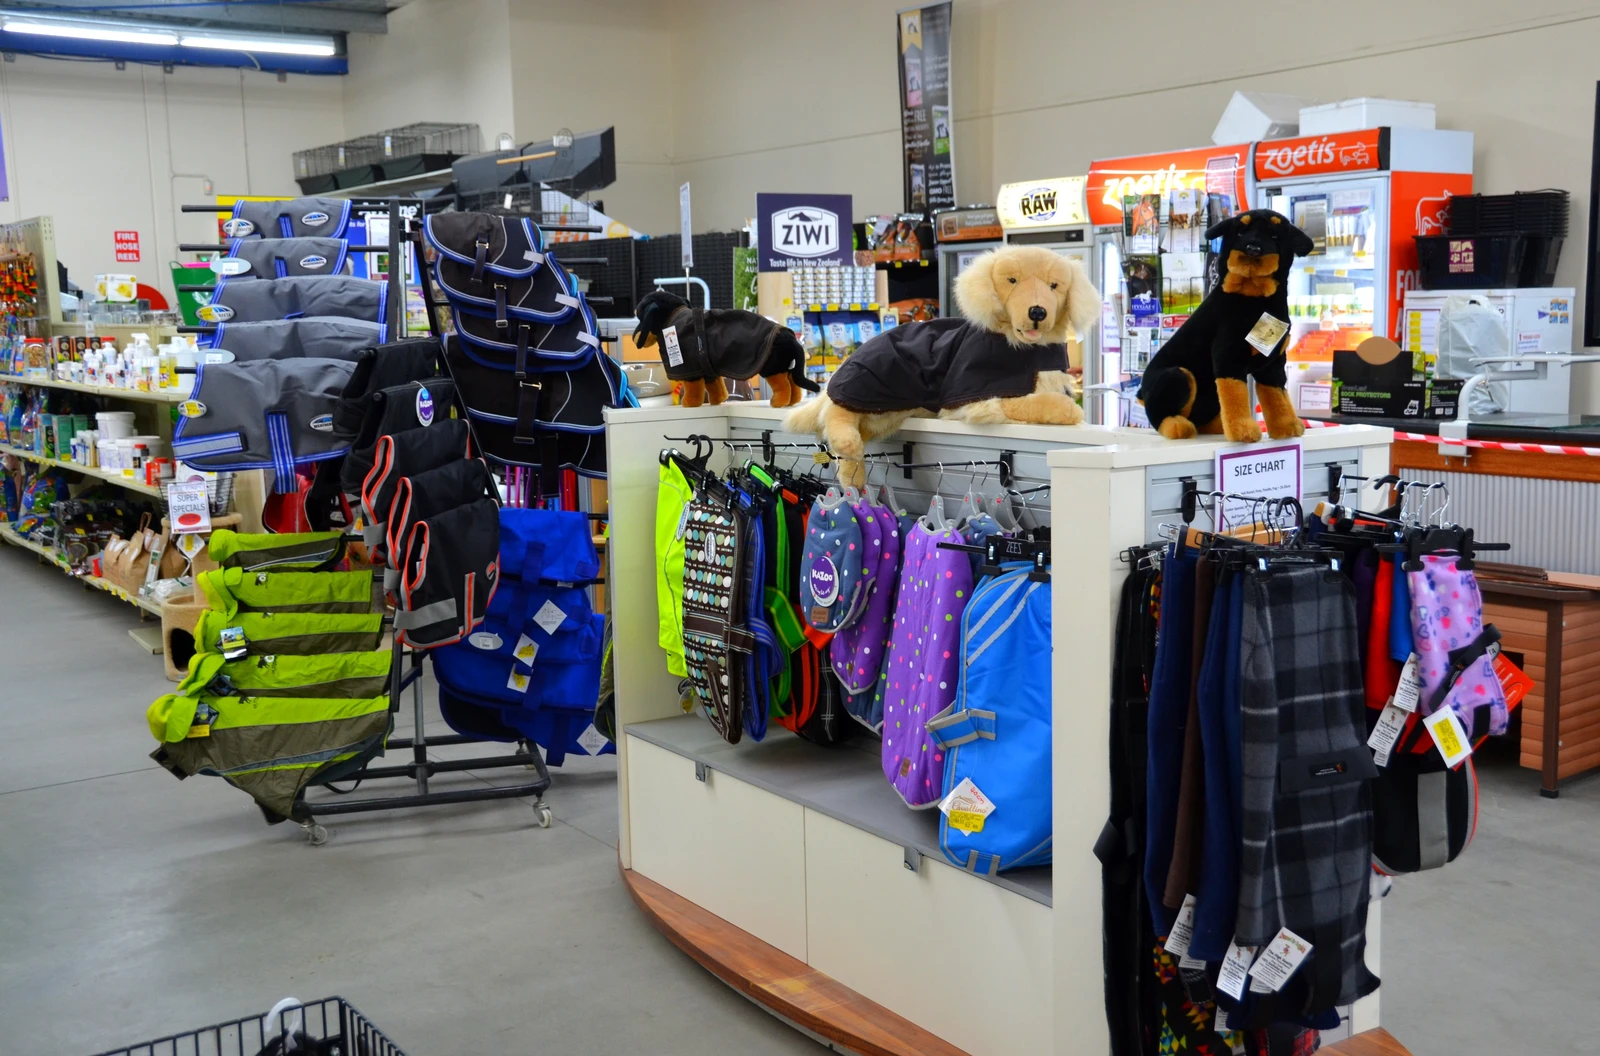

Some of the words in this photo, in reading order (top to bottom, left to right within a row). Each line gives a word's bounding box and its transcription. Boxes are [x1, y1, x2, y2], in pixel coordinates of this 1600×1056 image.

[1264, 136, 1336, 174] zoetis
[1021, 191, 1057, 216] RAW
[117, 233, 136, 241] FIRE
[782, 225, 829, 246] ZIWI
[116, 243, 138, 251] HOSE
[117, 253, 139, 261] REEL
[769, 258, 786, 267] Taste
[787, 258, 797, 267] life
[803, 258, 816, 267] New
[817, 258, 841, 267] Zealand
[1234, 464, 1252, 477] SIZE
[1254, 459, 1286, 474] CHART
[177, 493, 199, 502] SUPER
[173, 503, 205, 513] SPECIALS
